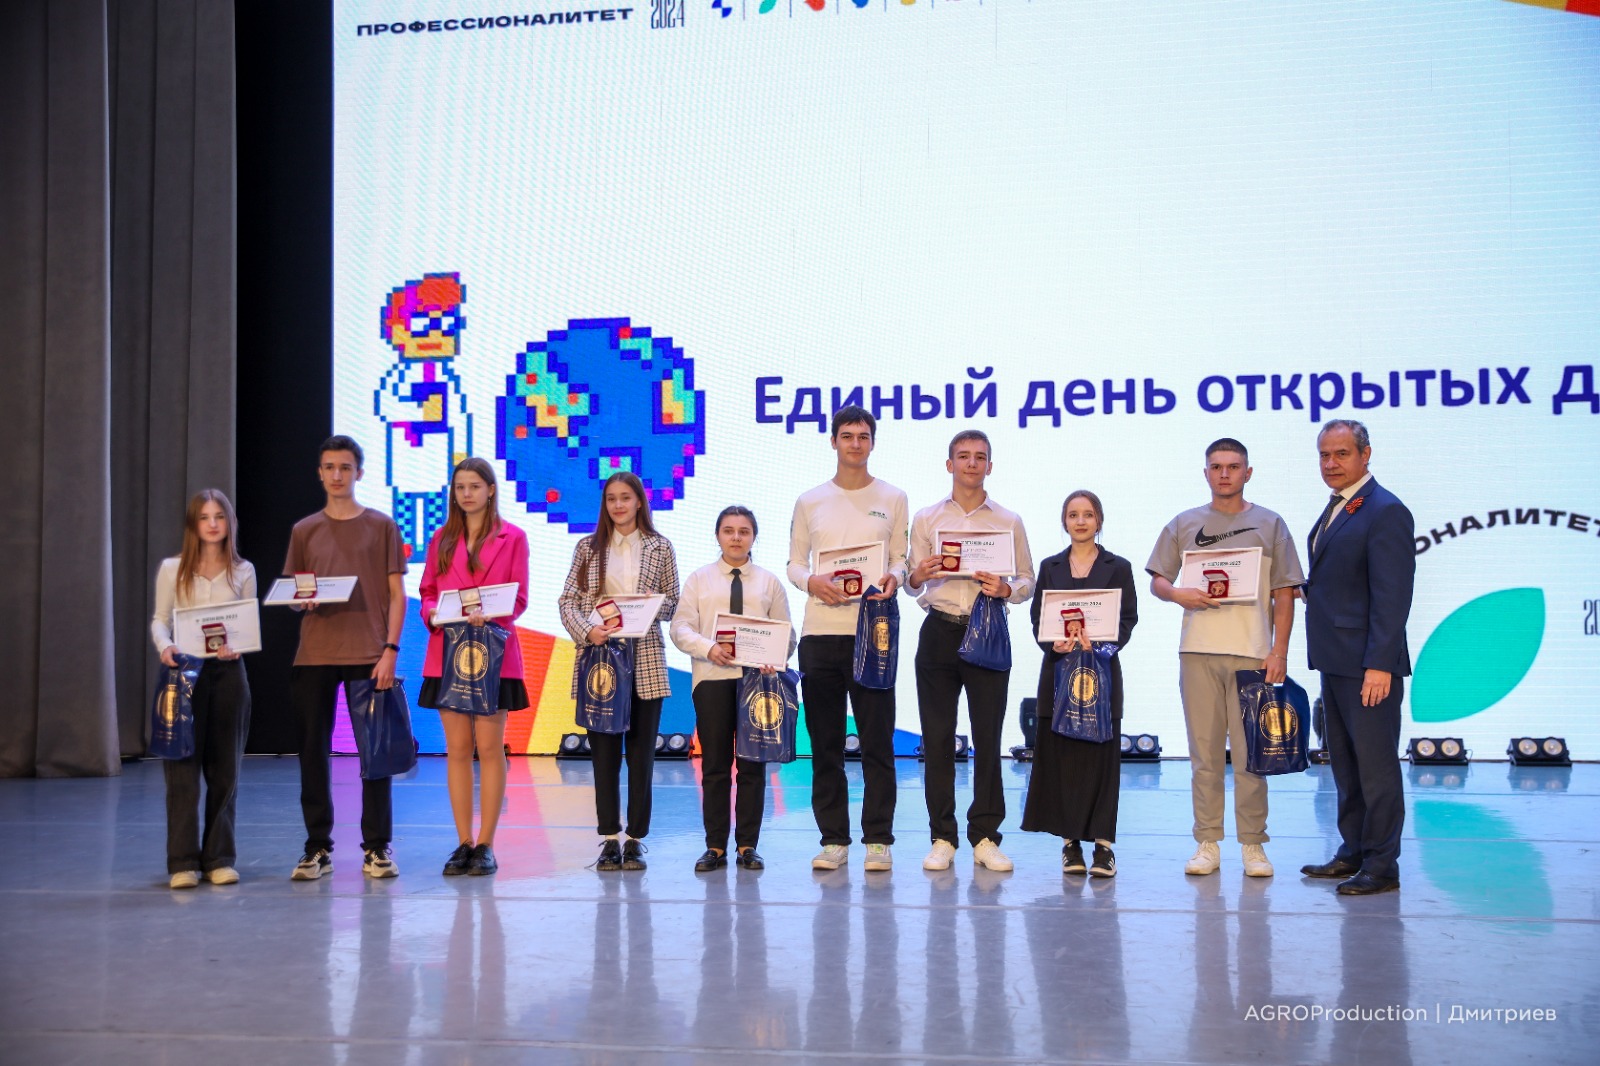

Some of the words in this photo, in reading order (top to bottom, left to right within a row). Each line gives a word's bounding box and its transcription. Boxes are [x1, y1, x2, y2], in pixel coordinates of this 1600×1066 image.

[357, 9, 634, 36] ПРОФЕССИОНАЛИТЕТ
[650, 0, 685, 29] 2024
[756, 366, 997, 434] Единый
[1019, 379, 1176, 428] день
[1198, 367, 1531, 422] открытых
[1216, 531, 1234, 541] NIKE
